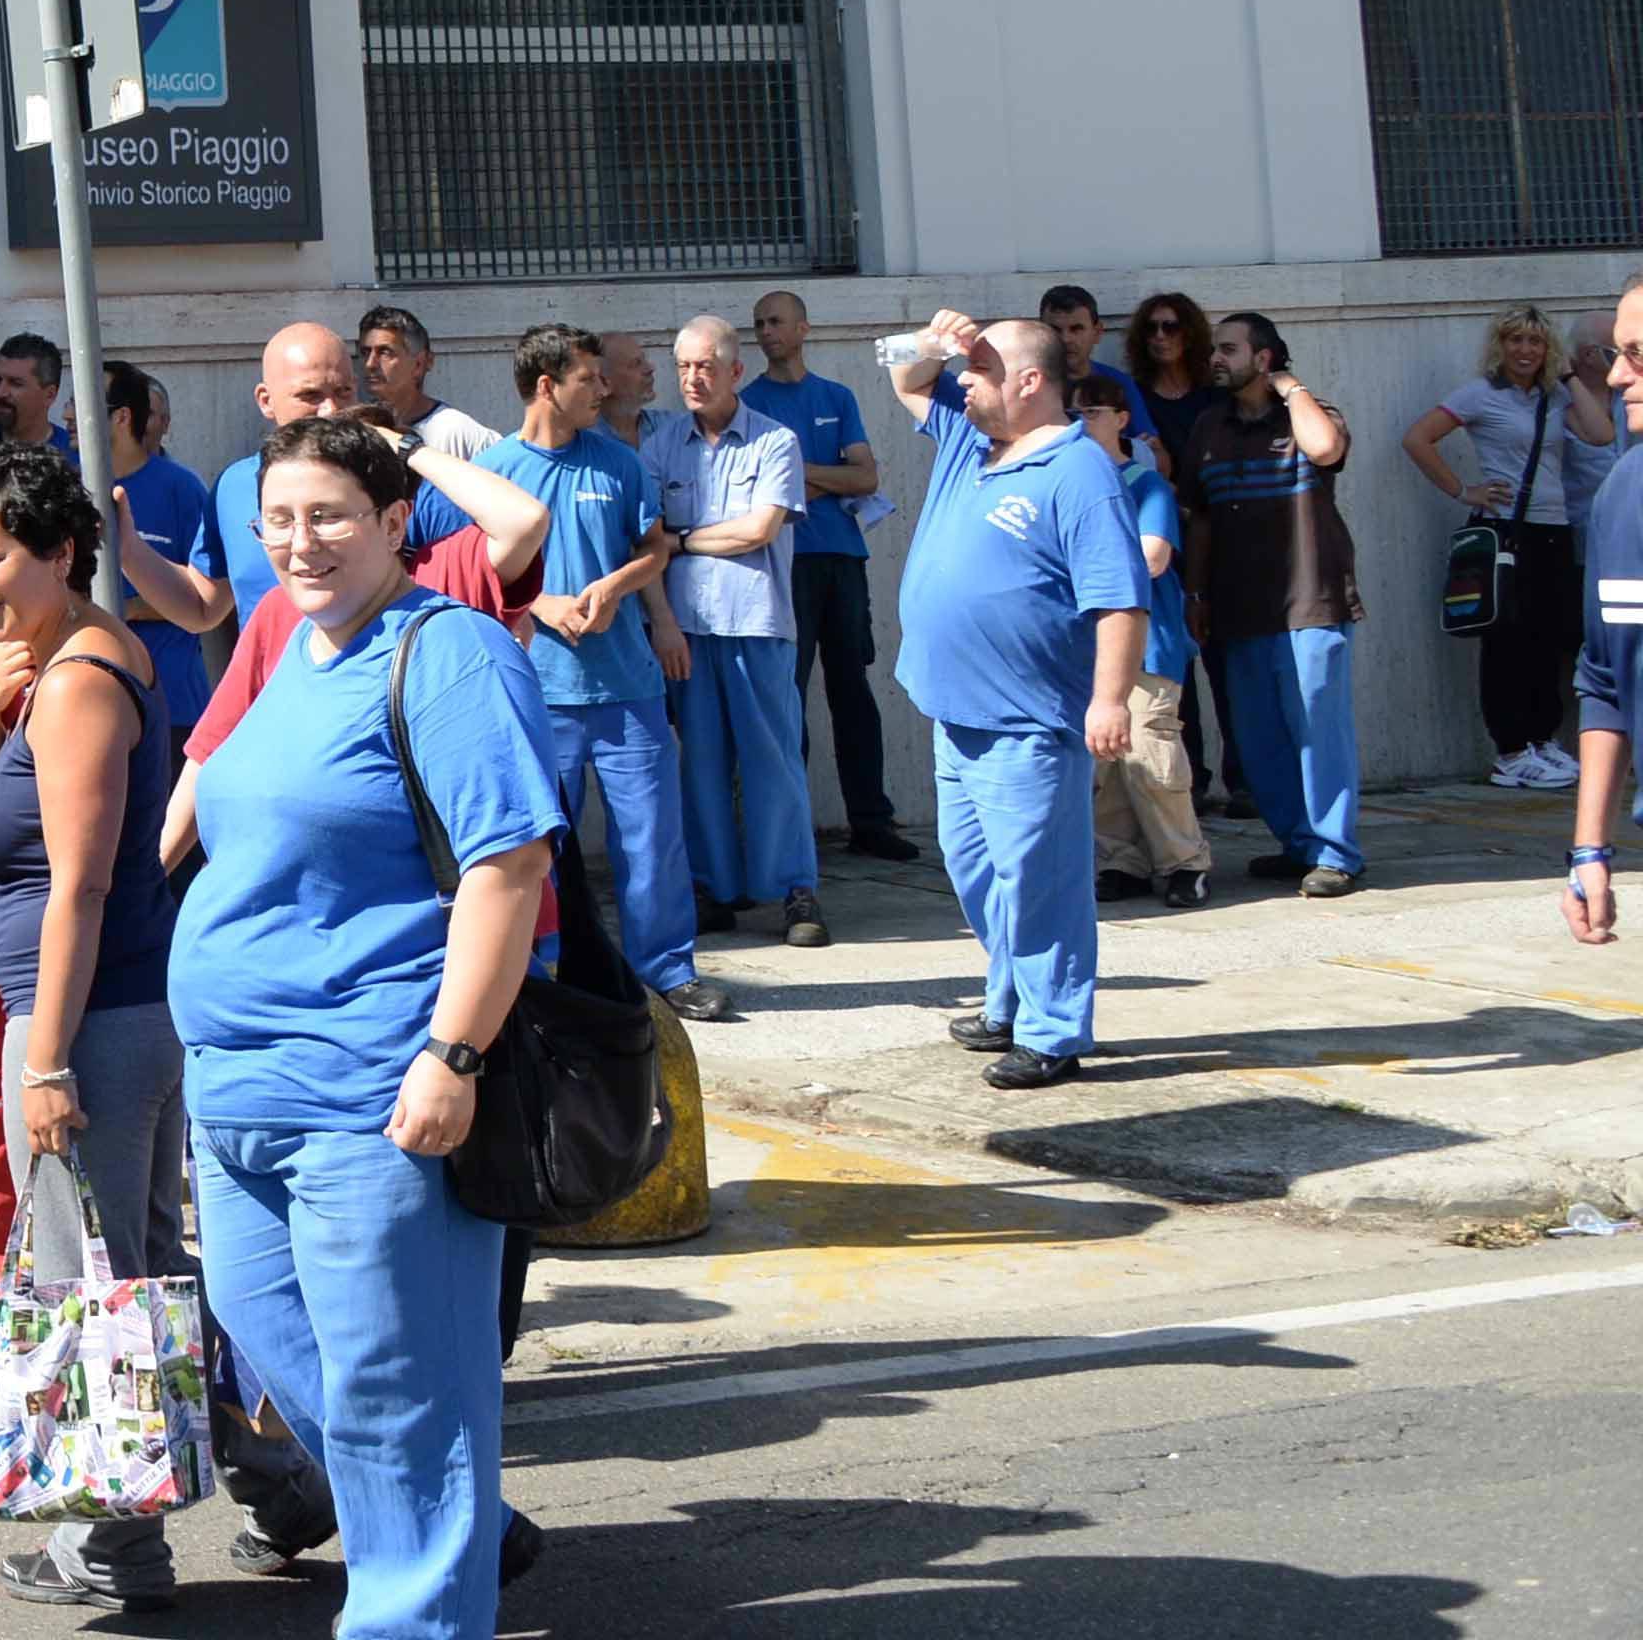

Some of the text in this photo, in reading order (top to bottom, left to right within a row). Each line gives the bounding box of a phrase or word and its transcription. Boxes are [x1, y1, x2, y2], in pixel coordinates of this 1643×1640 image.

[81, 128, 290, 175] useo Piaggio
[141, 180, 211, 205] Storico
[217, 180, 292, 210] Piaggio
